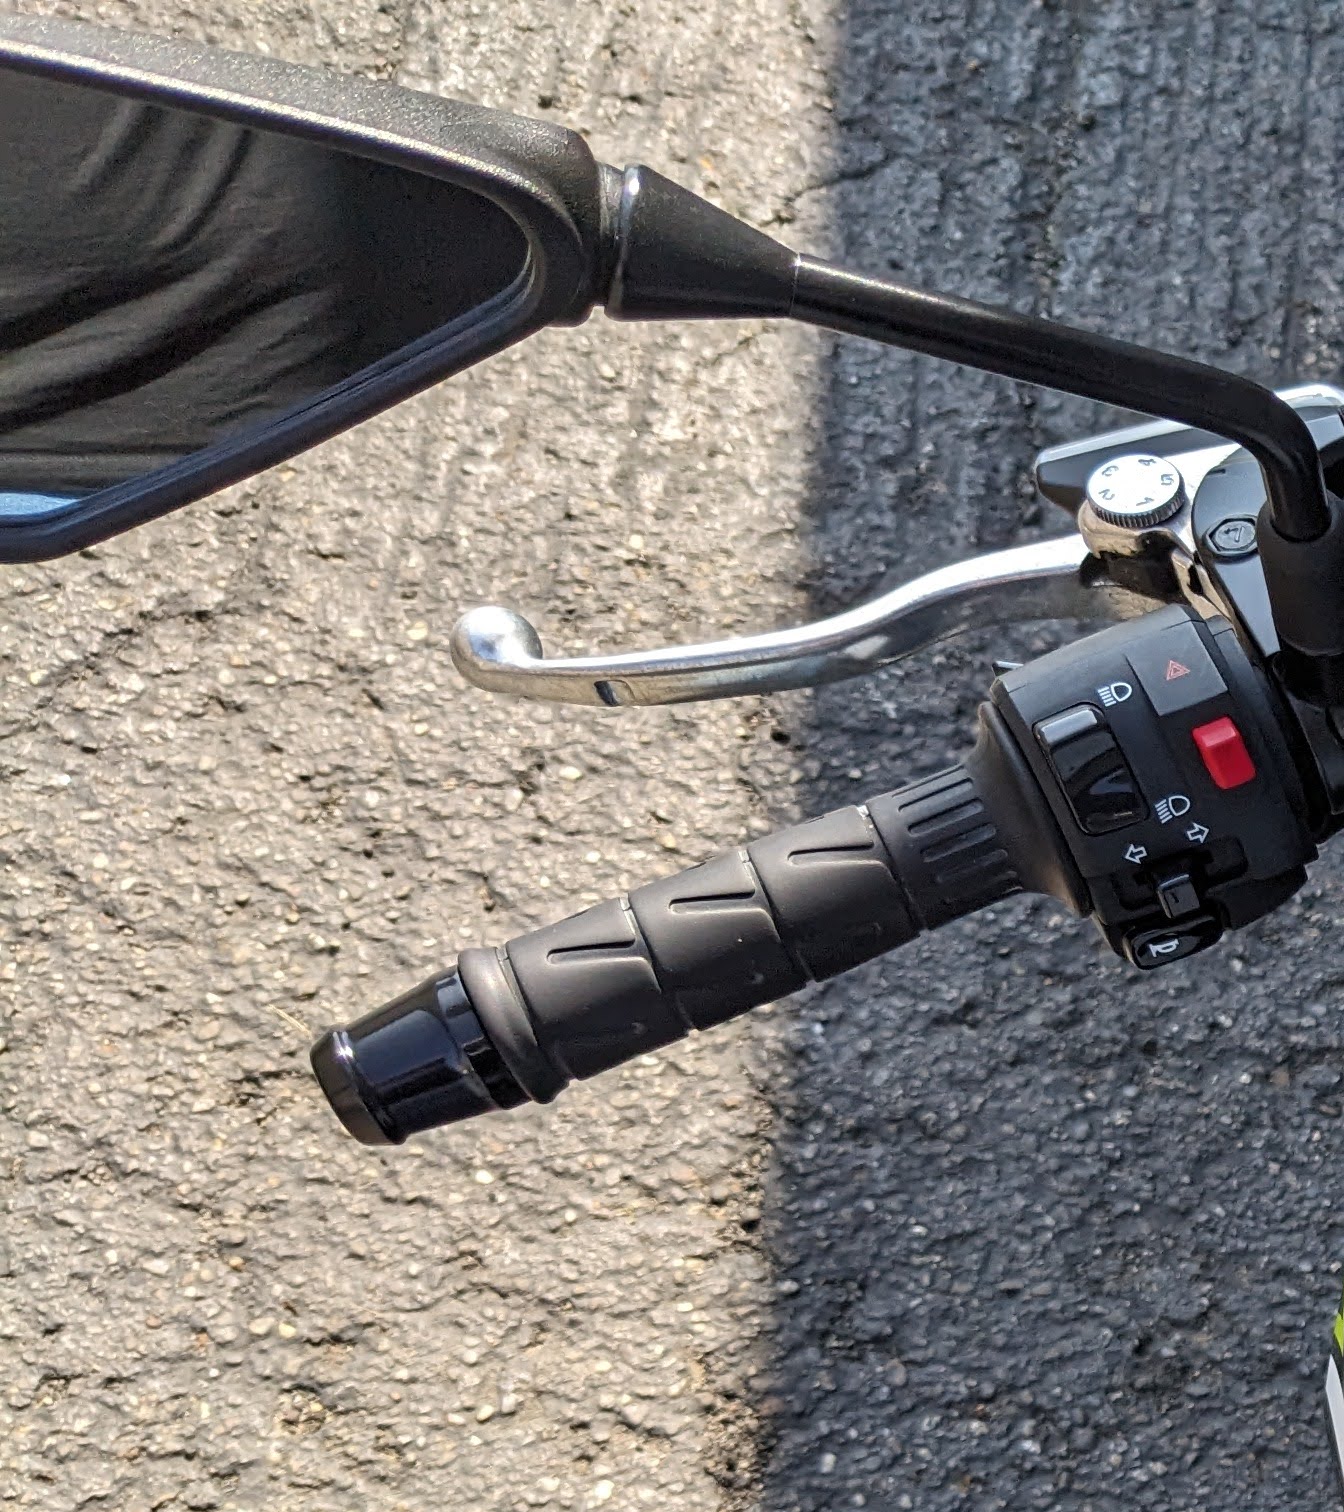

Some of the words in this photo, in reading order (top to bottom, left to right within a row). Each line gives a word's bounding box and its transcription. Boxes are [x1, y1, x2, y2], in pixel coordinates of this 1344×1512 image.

[1102, 465, 1119, 477] 3
[1160, 473, 1174, 486] 5
[1098, 488, 1115, 501] 2
